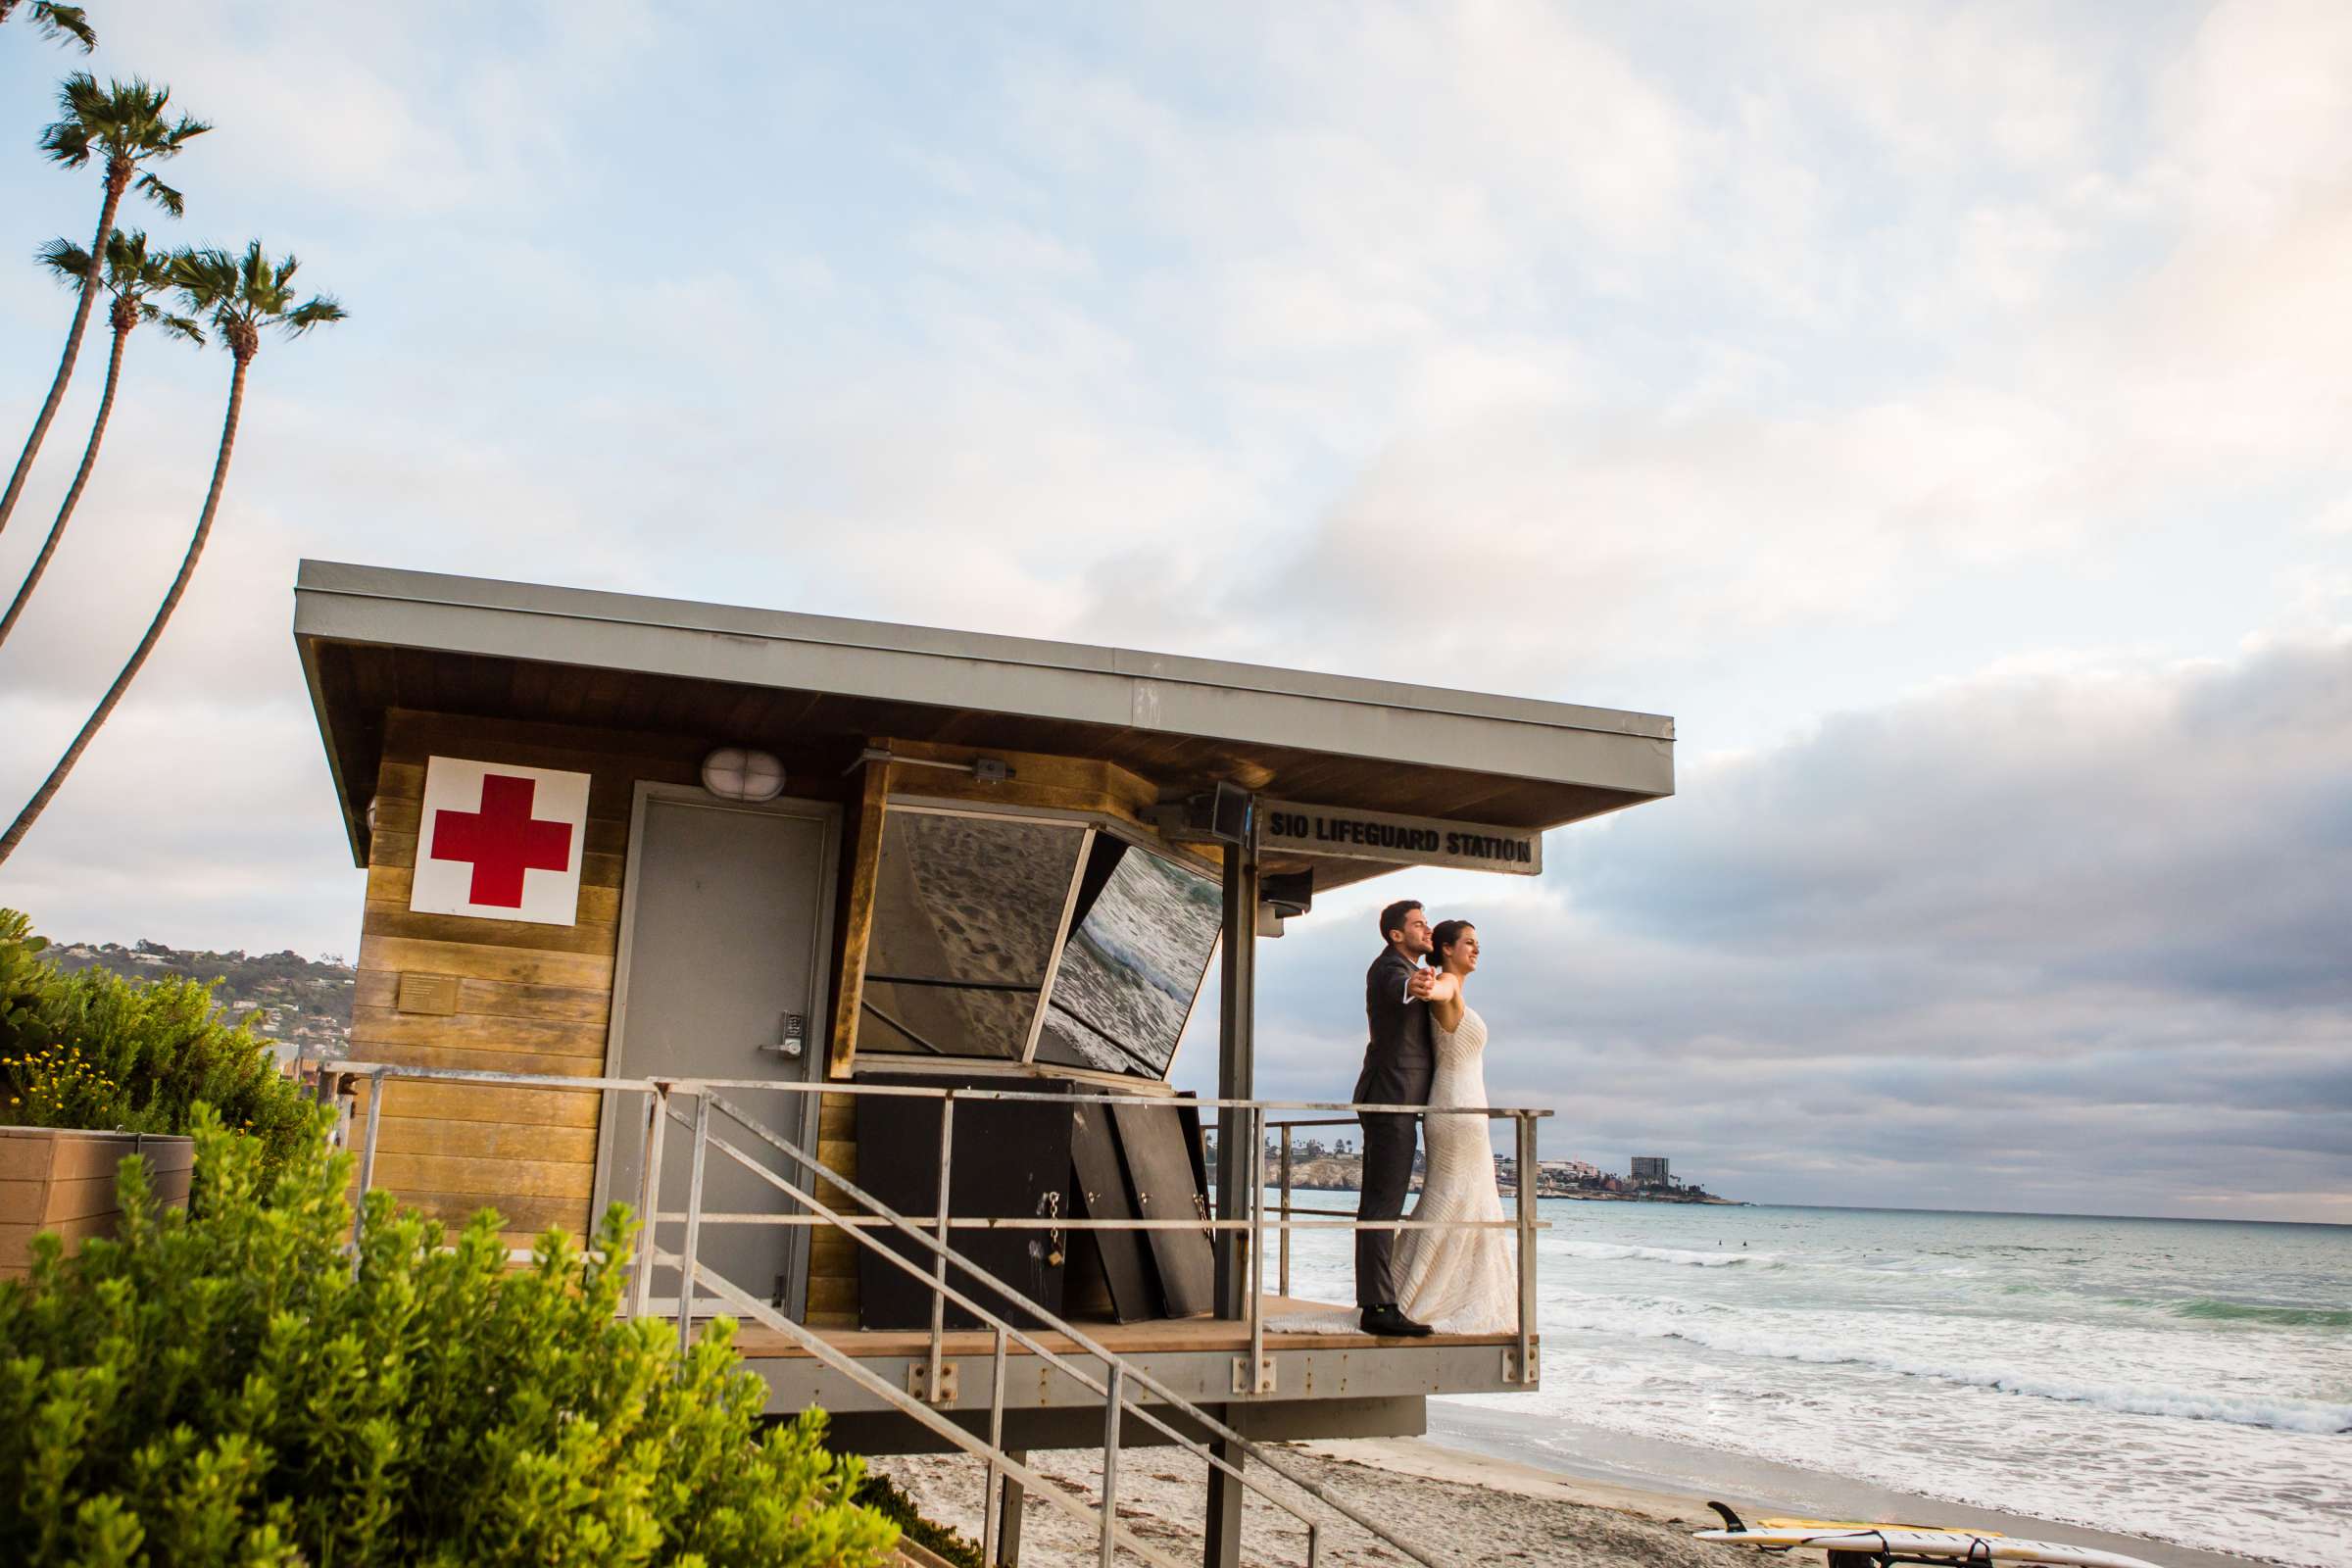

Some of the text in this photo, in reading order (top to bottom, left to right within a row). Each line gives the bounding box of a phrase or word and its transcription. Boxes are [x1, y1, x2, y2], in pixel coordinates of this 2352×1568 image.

[1270, 812, 1531, 863] SIO LIFEGUARD STATION
